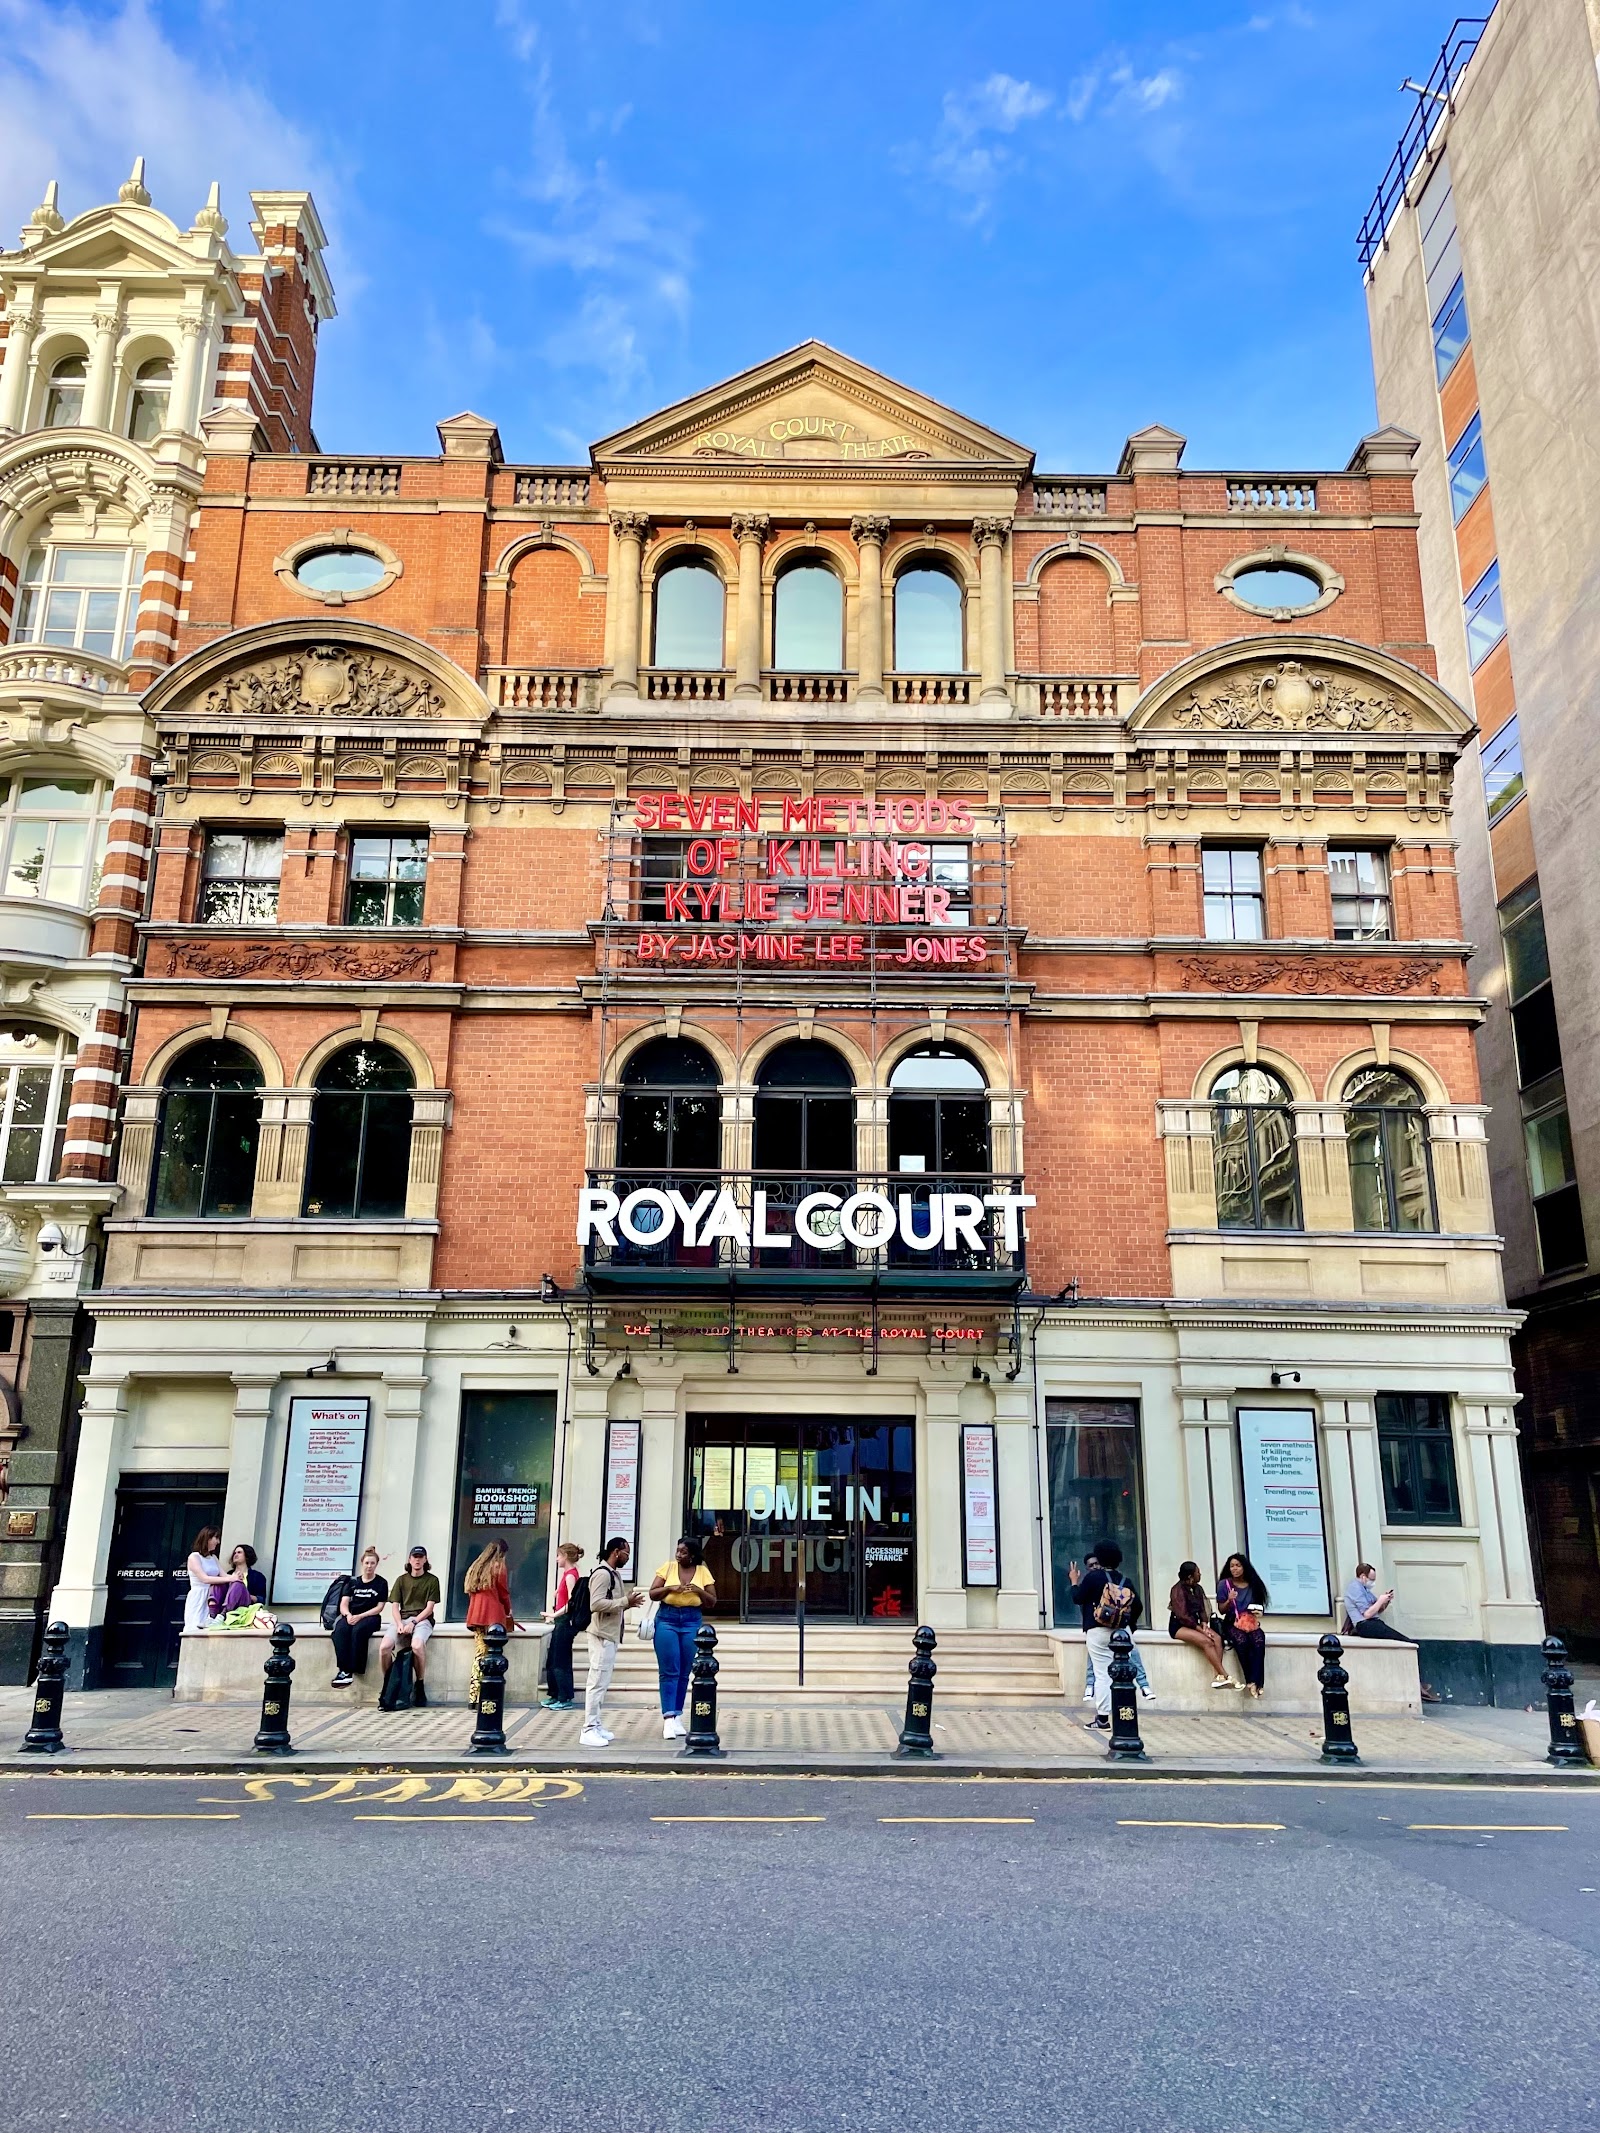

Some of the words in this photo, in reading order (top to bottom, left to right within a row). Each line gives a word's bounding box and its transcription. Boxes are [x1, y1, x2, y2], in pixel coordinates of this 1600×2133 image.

[769, 416, 855, 442] COURT
[697, 432, 775, 458] ROYAL
[633, 794, 760, 832] SEVEN
[782, 796, 976, 833] METHODS
[687, 839, 739, 875] OF
[768, 839, 928, 878] KILLING
[665, 882, 780, 920] KYLIE
[792, 884, 952, 924] JENNER
[637, 933, 679, 960] BY
[680, 934, 805, 960] JASMINE
[815, 936, 865, 962] LEE
[895, 936, 987, 964] JONES
[576, 1187, 792, 1248] ROYAL
[794, 1192, 1037, 1252] COURT
[623, 1324, 651, 1336] THE
[739, 1326, 813, 1338] THEATRES
[880, 1327, 927, 1339] ROYAL
[935, 1328, 985, 1340] COURT
[312, 1412, 345, 1420] What's
[347, 1412, 360, 1420] on
[1262, 1455, 1279, 1463] kylie
[1280, 1456, 1304, 1464] jenner
[1305, 1456, 1313, 1464] by
[845, 1485, 882, 1522] IN
[1264, 1488, 1297, 1496] Trending
[1265, 1509, 1286, 1517] Royal
[864, 1547, 909, 1555] ACCESSIBLE
[864, 1554, 903, 1562] ENTRANCE
[117, 1569, 135, 1577] FIRE
[135, 1569, 164, 1578] ESCAPE
[172, 1569, 189, 1577] KEE
[196, 1778, 585, 1803] STAND
